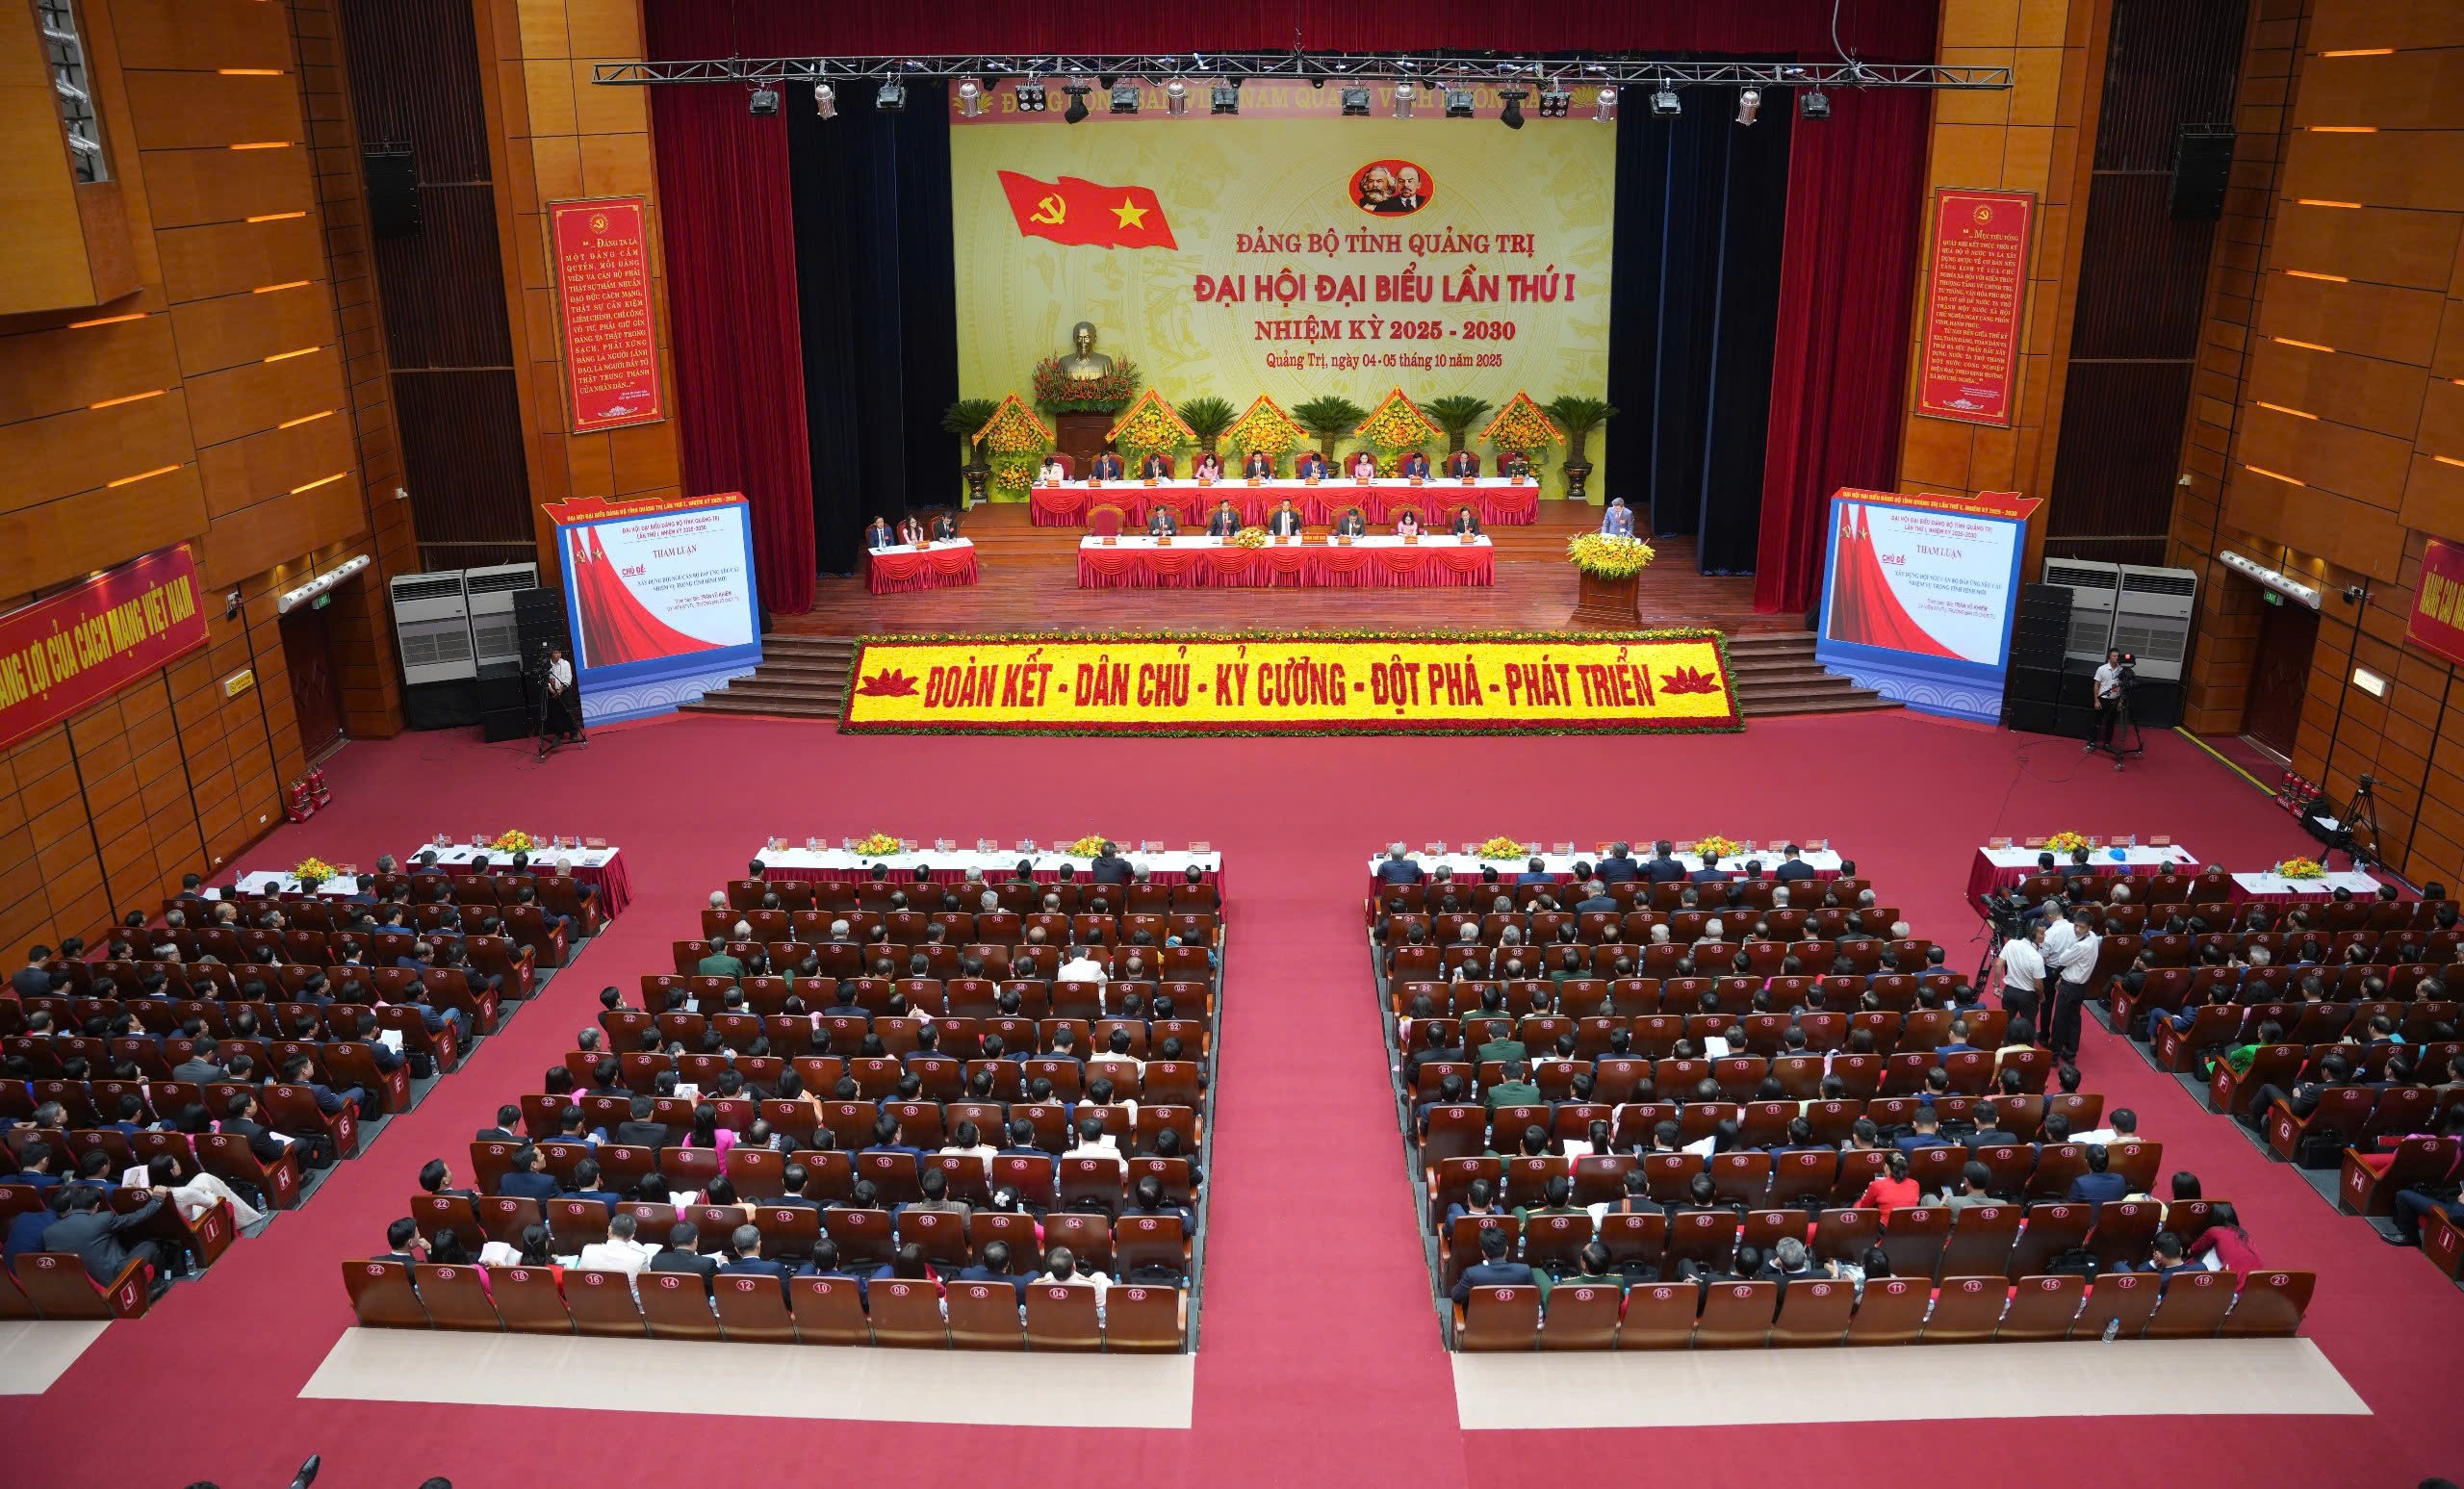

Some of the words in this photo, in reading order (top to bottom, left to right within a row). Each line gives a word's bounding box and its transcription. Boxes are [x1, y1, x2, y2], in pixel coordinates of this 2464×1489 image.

[1240, 87, 1290, 109] NAM
[1237, 225, 1301, 253] ĐẢNG
[1308, 227, 1340, 258] BỘ
[1345, 225, 1401, 253] TỈNH
[1408, 225, 1490, 257] QUẢNG
[1496, 234, 1534, 258] TRỊ
[1194, 274, 1245, 307] ĐẠI
[1254, 268, 1306, 308] HỘI
[1315, 274, 1366, 307] ĐẠI
[1375, 262, 1433, 302] BIỂU
[1443, 264, 1500, 302] LẦN
[1507, 264, 1560, 302] THỨ
[1564, 273, 1576, 301] I
[1255, 314, 1343, 345] NHIỆM
[1348, 313, 1385, 340] KỲ
[1389, 321, 1443, 340] 2025
[1462, 321, 1516, 340] 2030
[1267, 349, 1305, 370] Quảng
[1307, 353, 1328, 370] Trị,
[1331, 352, 1359, 371] ngày
[1399, 352, 1433, 371] tháng
[1434, 353, 1447, 367] 10
[1450, 353, 1474, 367] năm
[1476, 353, 1502, 368] 2025
[653, 547, 675, 558] THAM
[677, 545, 697, 556] LUẬN
[1916, 544, 1938, 555] THAM
[1940, 547, 1962, 559] LUẬN
[622, 566, 634, 576] CHỦ
[319, 595, 328, 606] EXIT
[2267, 591, 2277, 603] EXIT
[22, 639, 52, 701] LỢI
[46, 619, 80, 683] CỦA
[73, 612, 113, 670] CÁCH
[106, 599, 147, 657] MẠNG
[141, 580, 169, 641] VIỆT
[165, 575, 195, 625] NAM
[924, 655, 998, 707] ĐOÀN
[1001, 648, 1054, 707] KẾT
[1075, 654, 1130, 706] DÂN
[1137, 645, 1192, 706] CHỦ
[1216, 645, 1249, 706] KỶ
[1370, 654, 1421, 715] ĐỘT
[1429, 654, 1484, 706] PHÁ
[1505, 654, 1572, 707] PHÁT
[1576, 646, 1656, 707] TRIỂN
[2166, 1040, 2173, 1052] E
[2276, 1047, 2289, 1056] 23
[2220, 1075, 2227, 1088] F
[2345, 1091, 2357, 1100] 23
[340, 1120, 349, 1135] G
[2281, 1123, 2290, 1137] G
[213, 1137, 226, 1146] 24
[2425, 1142, 2437, 1151] 23
[1082, 1161, 1094, 1169] 04
[1151, 1161, 1164, 1169] 02
[1465, 1161, 1476, 1169] 01
[1530, 1161, 1544, 1169] 03
[278, 1171, 290, 1186] H
[2352, 1172, 2363, 1187] H
[436, 1200, 448, 1209] 22
[501, 1201, 514, 1211] 20
[571, 1204, 583, 1214] 18
[638, 1208, 651, 1217] 16
[709, 1210, 722, 1219] 14
[1984, 1209, 1996, 1219] 15
[2055, 1207, 2066, 1217] 17
[2123, 1206, 2136, 1215] 19
[1770, 1214, 1782, 1222] 09
[1843, 1213, 1856, 1221] 11
[1914, 1212, 1927, 1220] 13
[922, 1217, 935, 1225] 08
[995, 1219, 1007, 1227] 06
[1068, 1219, 1081, 1228] 04
[1142, 1220, 1153, 1229] 02
[1481, 1219, 1493, 1228] 01
[1555, 1219, 1568, 1228] 03
[1629, 1218, 1641, 1227] 05
[1699, 1217, 1711, 1225] 07
[40, 1258, 53, 1268] 24
[441, 1269, 452, 1278] 20
[514, 1271, 526, 1280] 18
[589, 1274, 601, 1284] 16
[664, 1278, 677, 1287] 14
[2122, 1278, 2134, 1287] 17
[2198, 1276, 2210, 1285] 19
[2274, 1276, 2286, 1285] 21
[740, 1280, 753, 1290] 12
[816, 1283, 829, 1292] 10
[1891, 1283, 1903, 1292] 11
[1967, 1282, 1980, 1291] 13
[125, 1287, 134, 1303] J
[894, 1286, 906, 1295] 08
[1053, 1289, 1065, 1297] 04
[1131, 1291, 1143, 1299] 02
[1499, 1291, 1511, 1299] 01
[1736, 1288, 1749, 1297] 07
